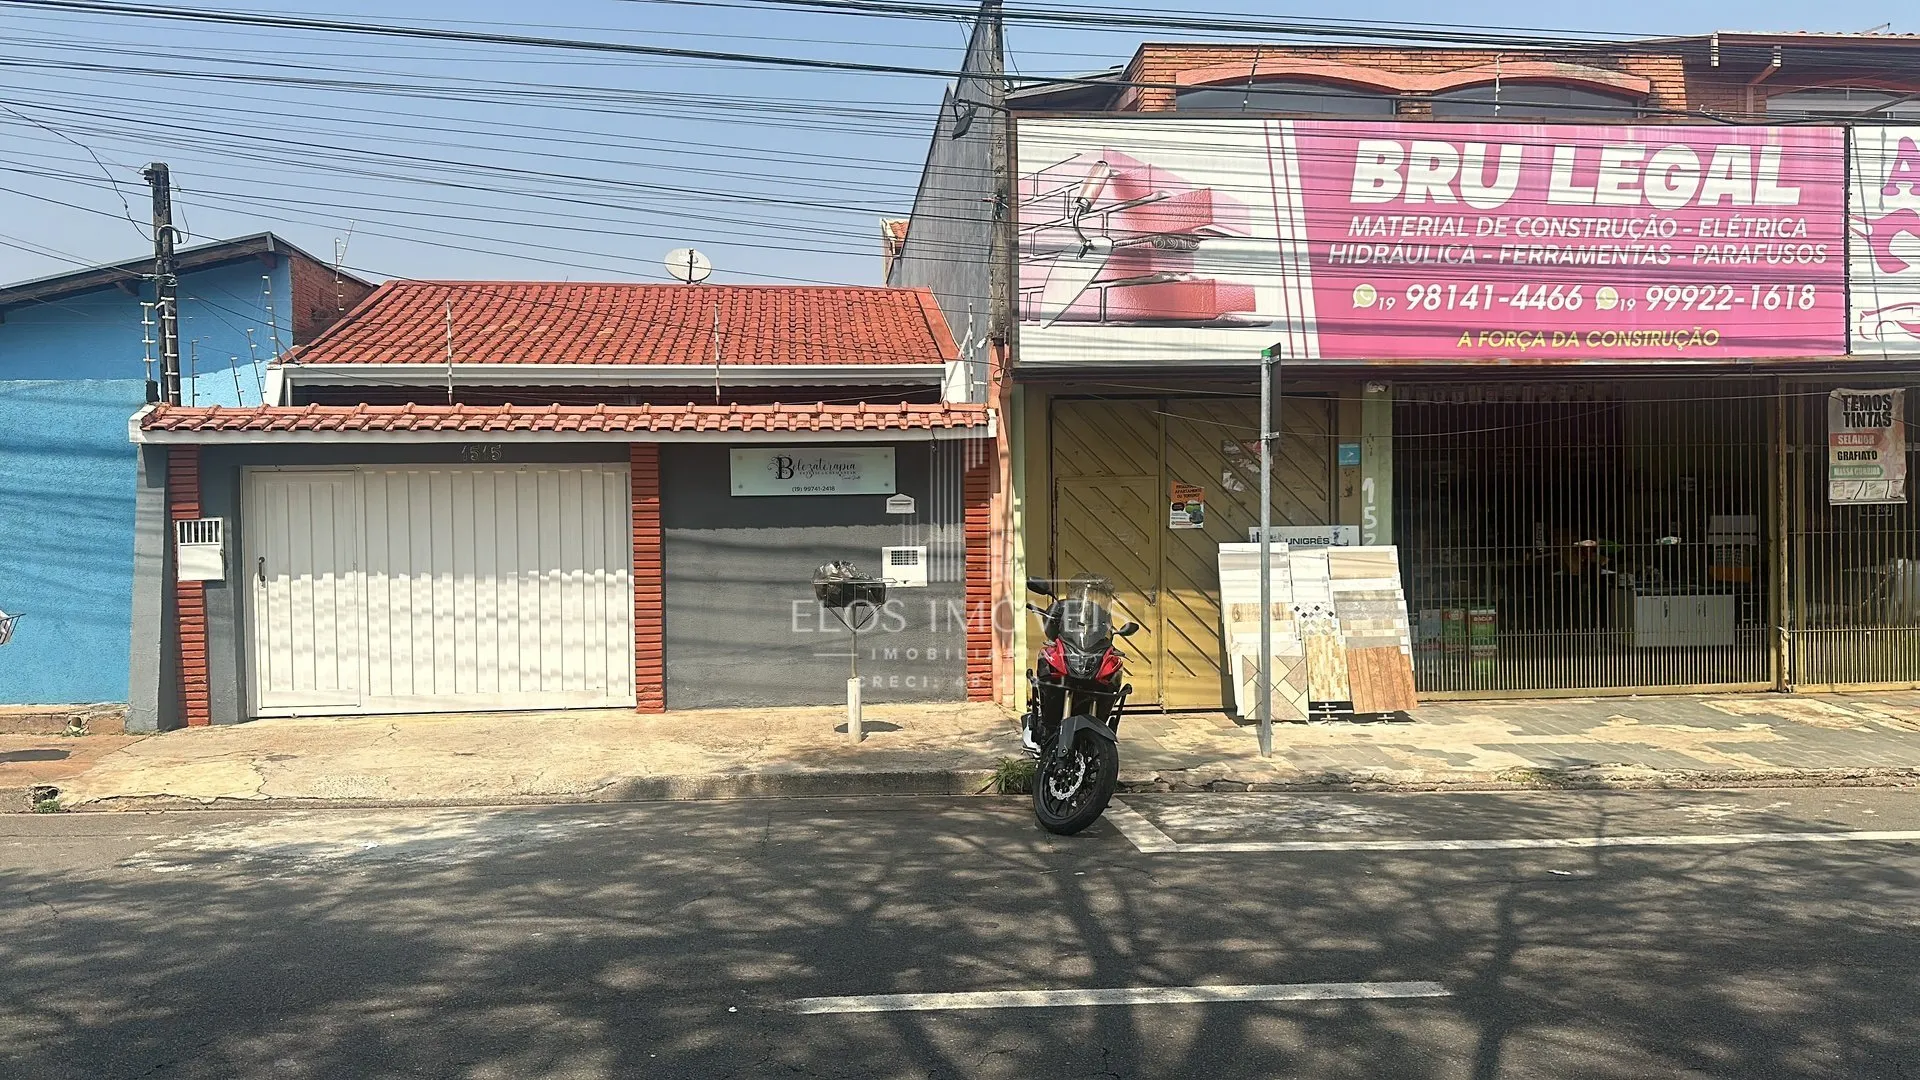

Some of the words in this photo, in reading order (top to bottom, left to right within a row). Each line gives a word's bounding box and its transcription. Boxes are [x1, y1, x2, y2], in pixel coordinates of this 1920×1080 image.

[1350, 140, 1523, 209] BRU
[1547, 143, 1801, 210] LEGAL
[1348, 216, 1469, 237] MATERIAL
[1476, 217, 1511, 237] DE
[1515, 214, 1677, 241] CONSTRUÇÃO
[1698, 214, 1808, 238] ELÉTRICA
[1328, 240, 1476, 265] HIDRÁULICA
[1499, 244, 1672, 265] FERRAMENTAS
[1692, 243, 1828, 265] PARAFUSOS
[1378, 297, 1396, 311] 19
[1405, 284, 1583, 311] 98141-4466
[1620, 299, 1636, 312] 19
[1646, 284, 1816, 311] 99922-1618
[1457, 331, 1473, 348] A
[1477, 330, 1546, 352] FORÇA
[1551, 331, 1580, 348] DA
[1585, 327, 1720, 351] CONSTRUÇÃO
[1841, 394, 1893, 412] TEMOS
[1843, 411, 1892, 428] TINTAS
[1838, 434, 1875, 445] SELADOR
[1837, 450, 1878, 461] GRAFIATO
